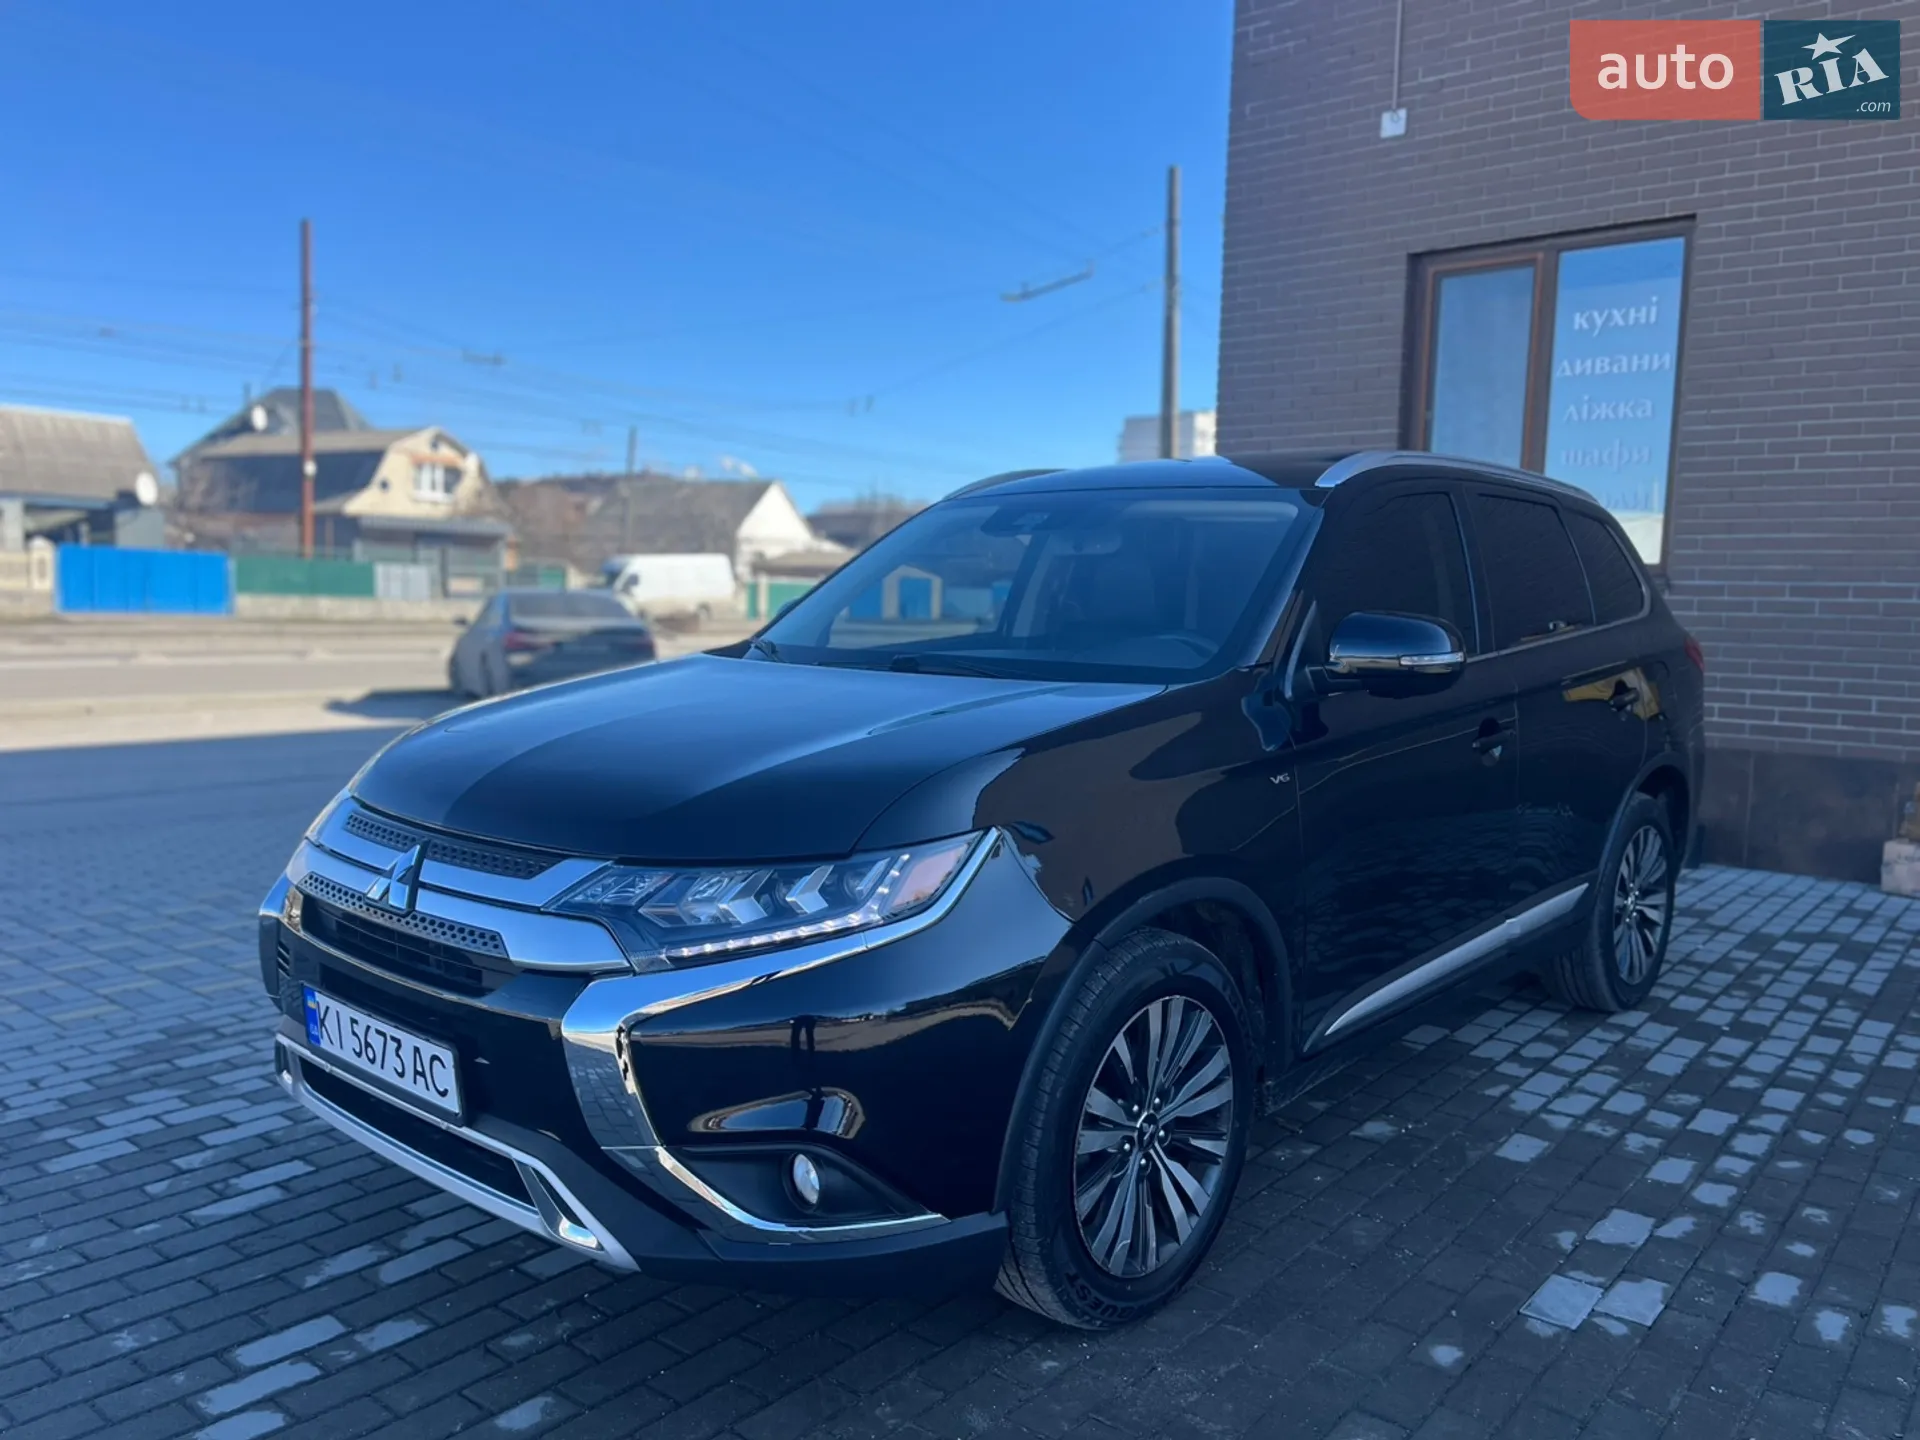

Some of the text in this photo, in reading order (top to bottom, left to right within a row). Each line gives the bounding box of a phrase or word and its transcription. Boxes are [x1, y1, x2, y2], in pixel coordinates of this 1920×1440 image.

[1573, 296, 1658, 337] кухні
[1556, 353, 1671, 377] дивани
[1563, 395, 1654, 423] ліжка
[1560, 437, 1652, 473] шафи
[350, 1016, 406, 1079] 5673
[413, 1045, 449, 1098] AC
